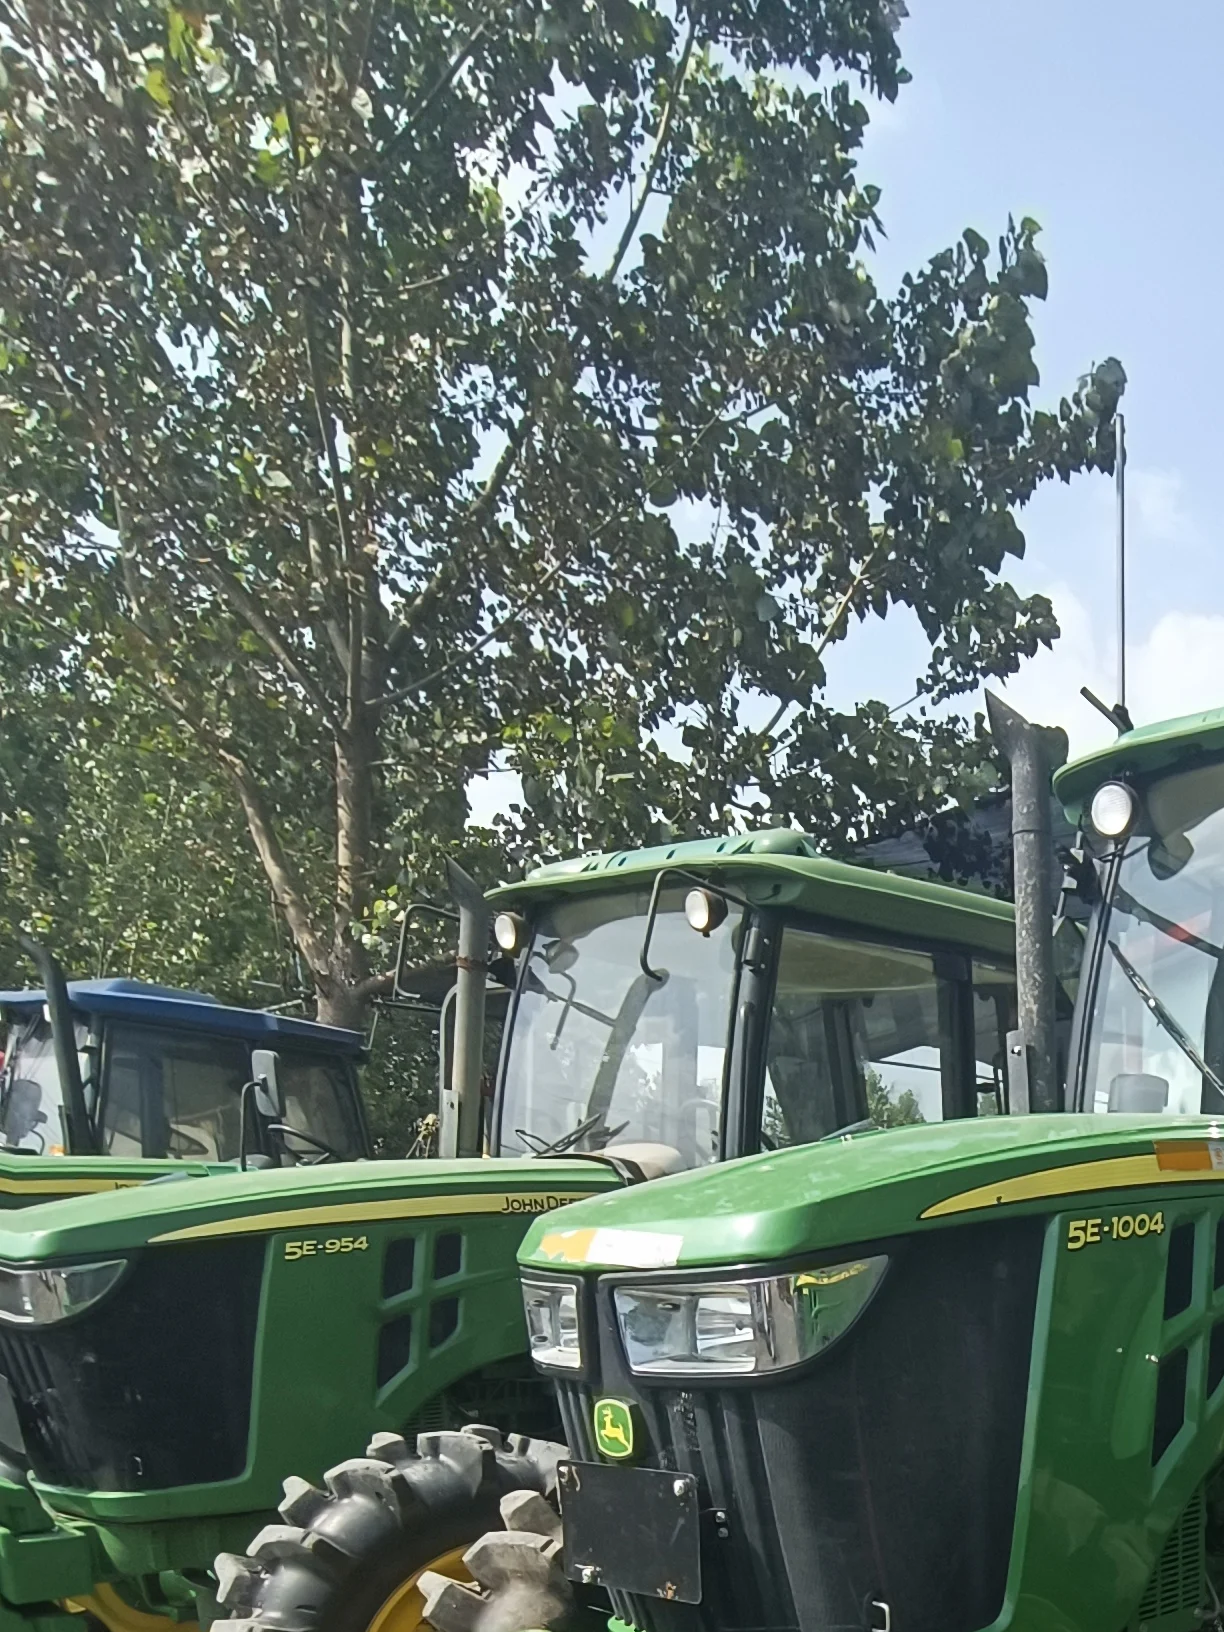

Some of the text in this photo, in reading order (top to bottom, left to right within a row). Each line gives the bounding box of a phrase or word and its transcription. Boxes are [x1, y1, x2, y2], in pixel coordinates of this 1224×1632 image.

[501, 1196, 545, 1212] JOHN
[1067, 1211, 1165, 1250] 5E-1004
[284, 1236, 369, 1260] 5E-954
